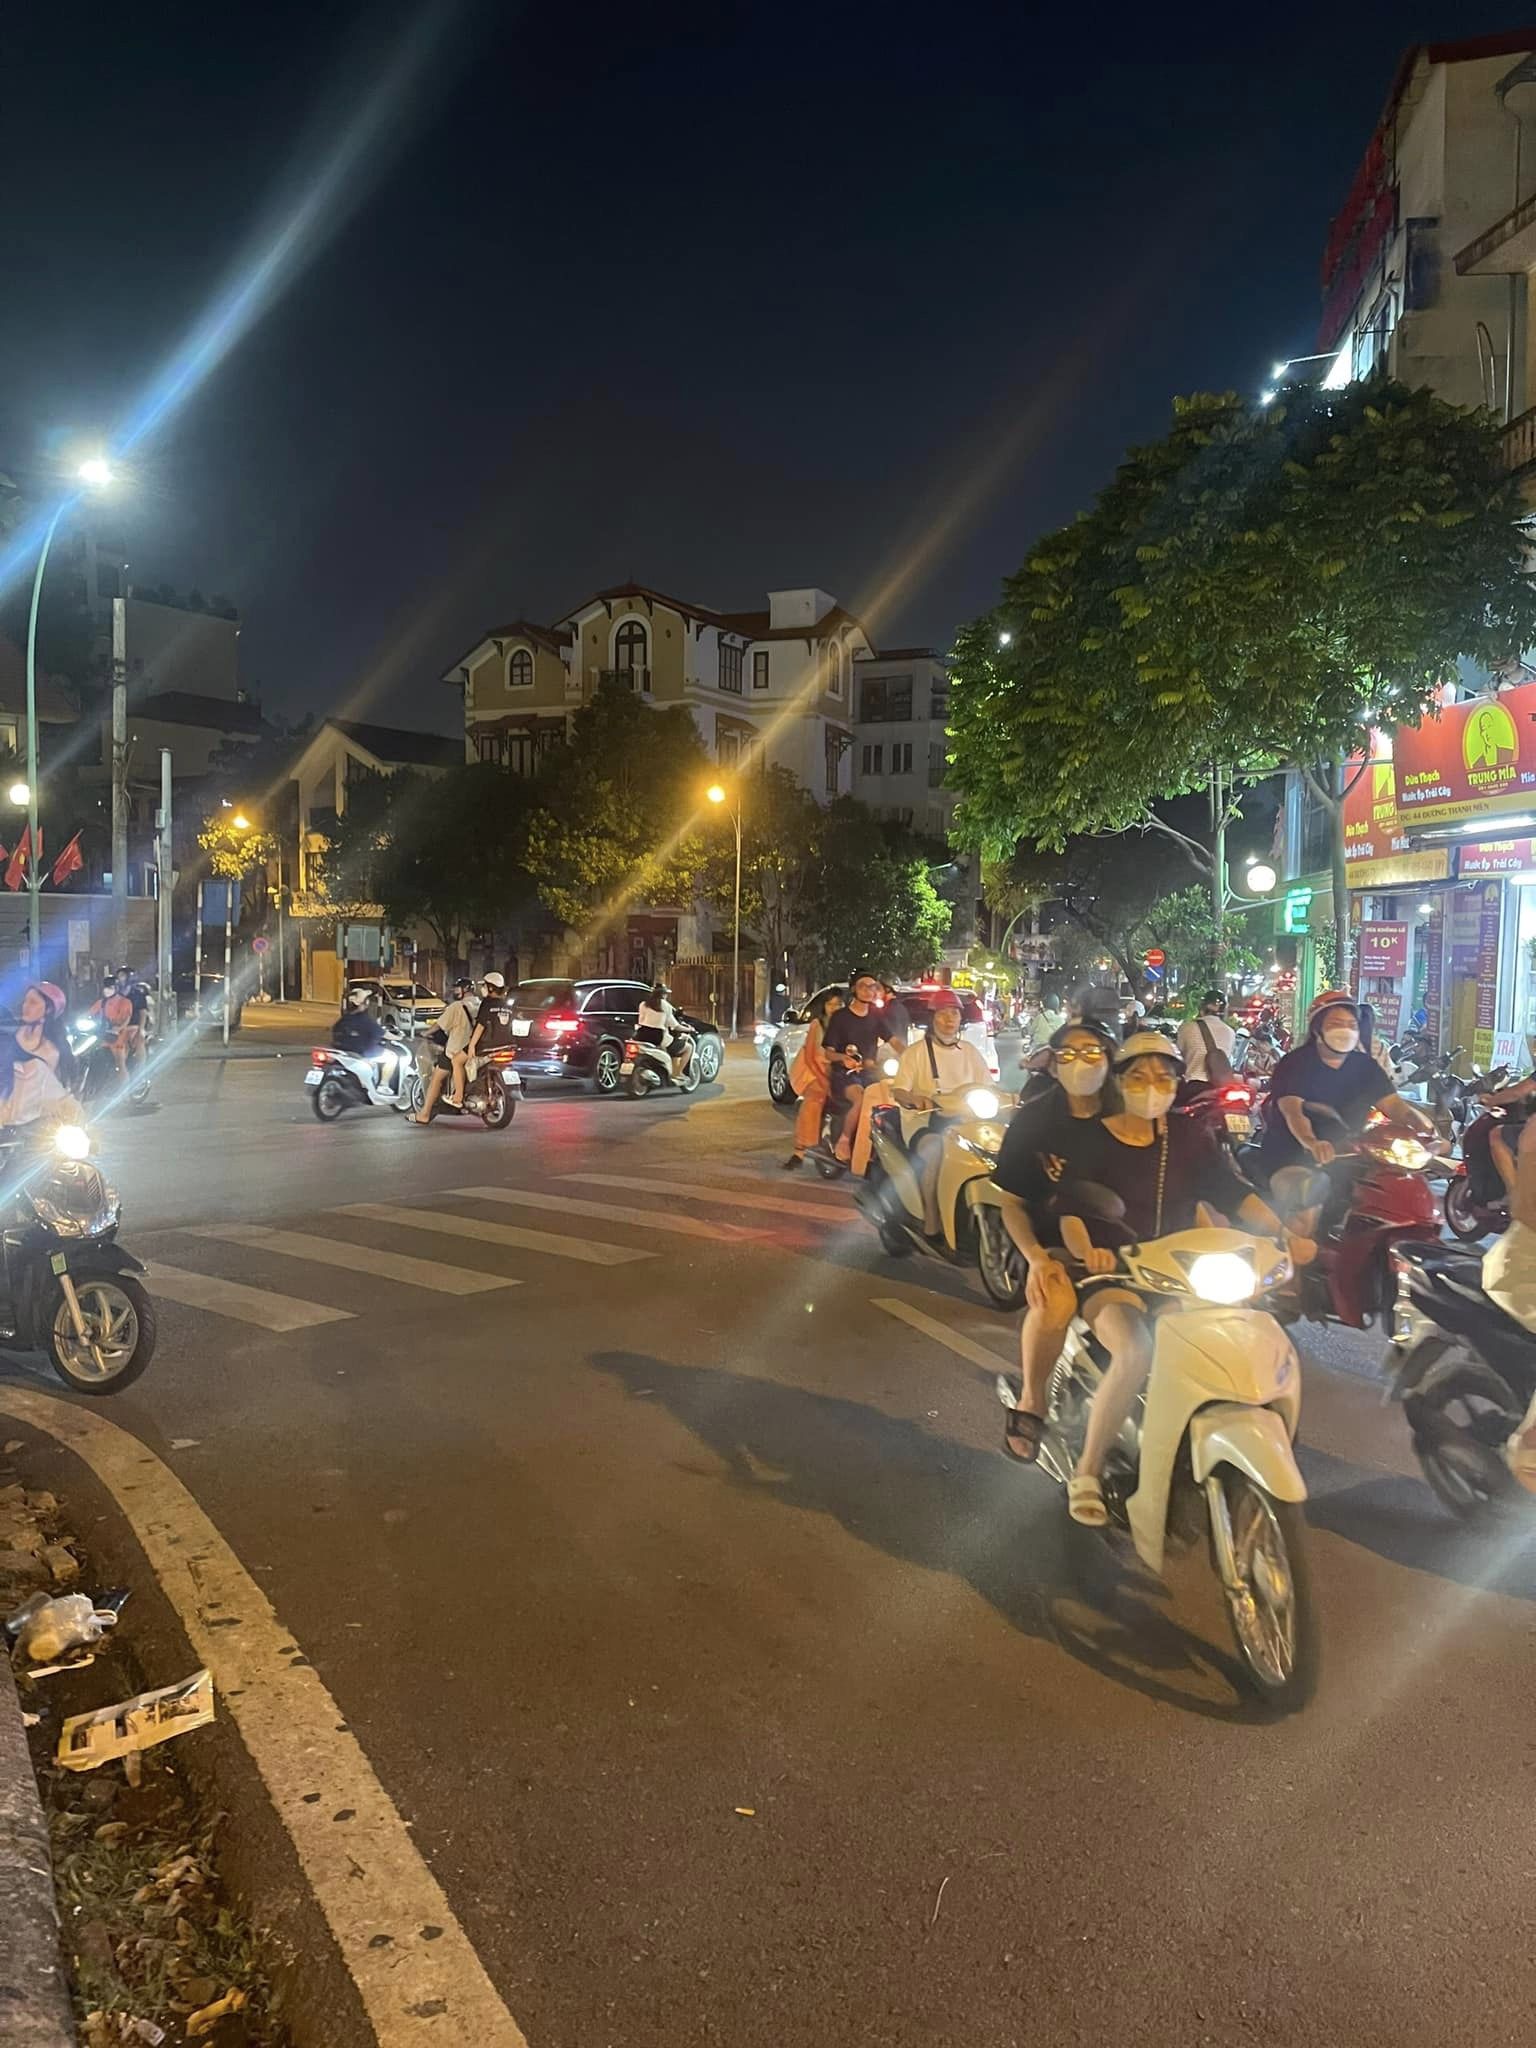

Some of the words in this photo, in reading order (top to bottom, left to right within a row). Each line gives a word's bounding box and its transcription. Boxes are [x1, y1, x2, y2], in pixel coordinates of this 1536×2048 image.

[1467, 770, 1497, 786] TRUNG
[1498, 764, 1517, 780] MÍA
[1370, 936, 1398, 948] 10K
